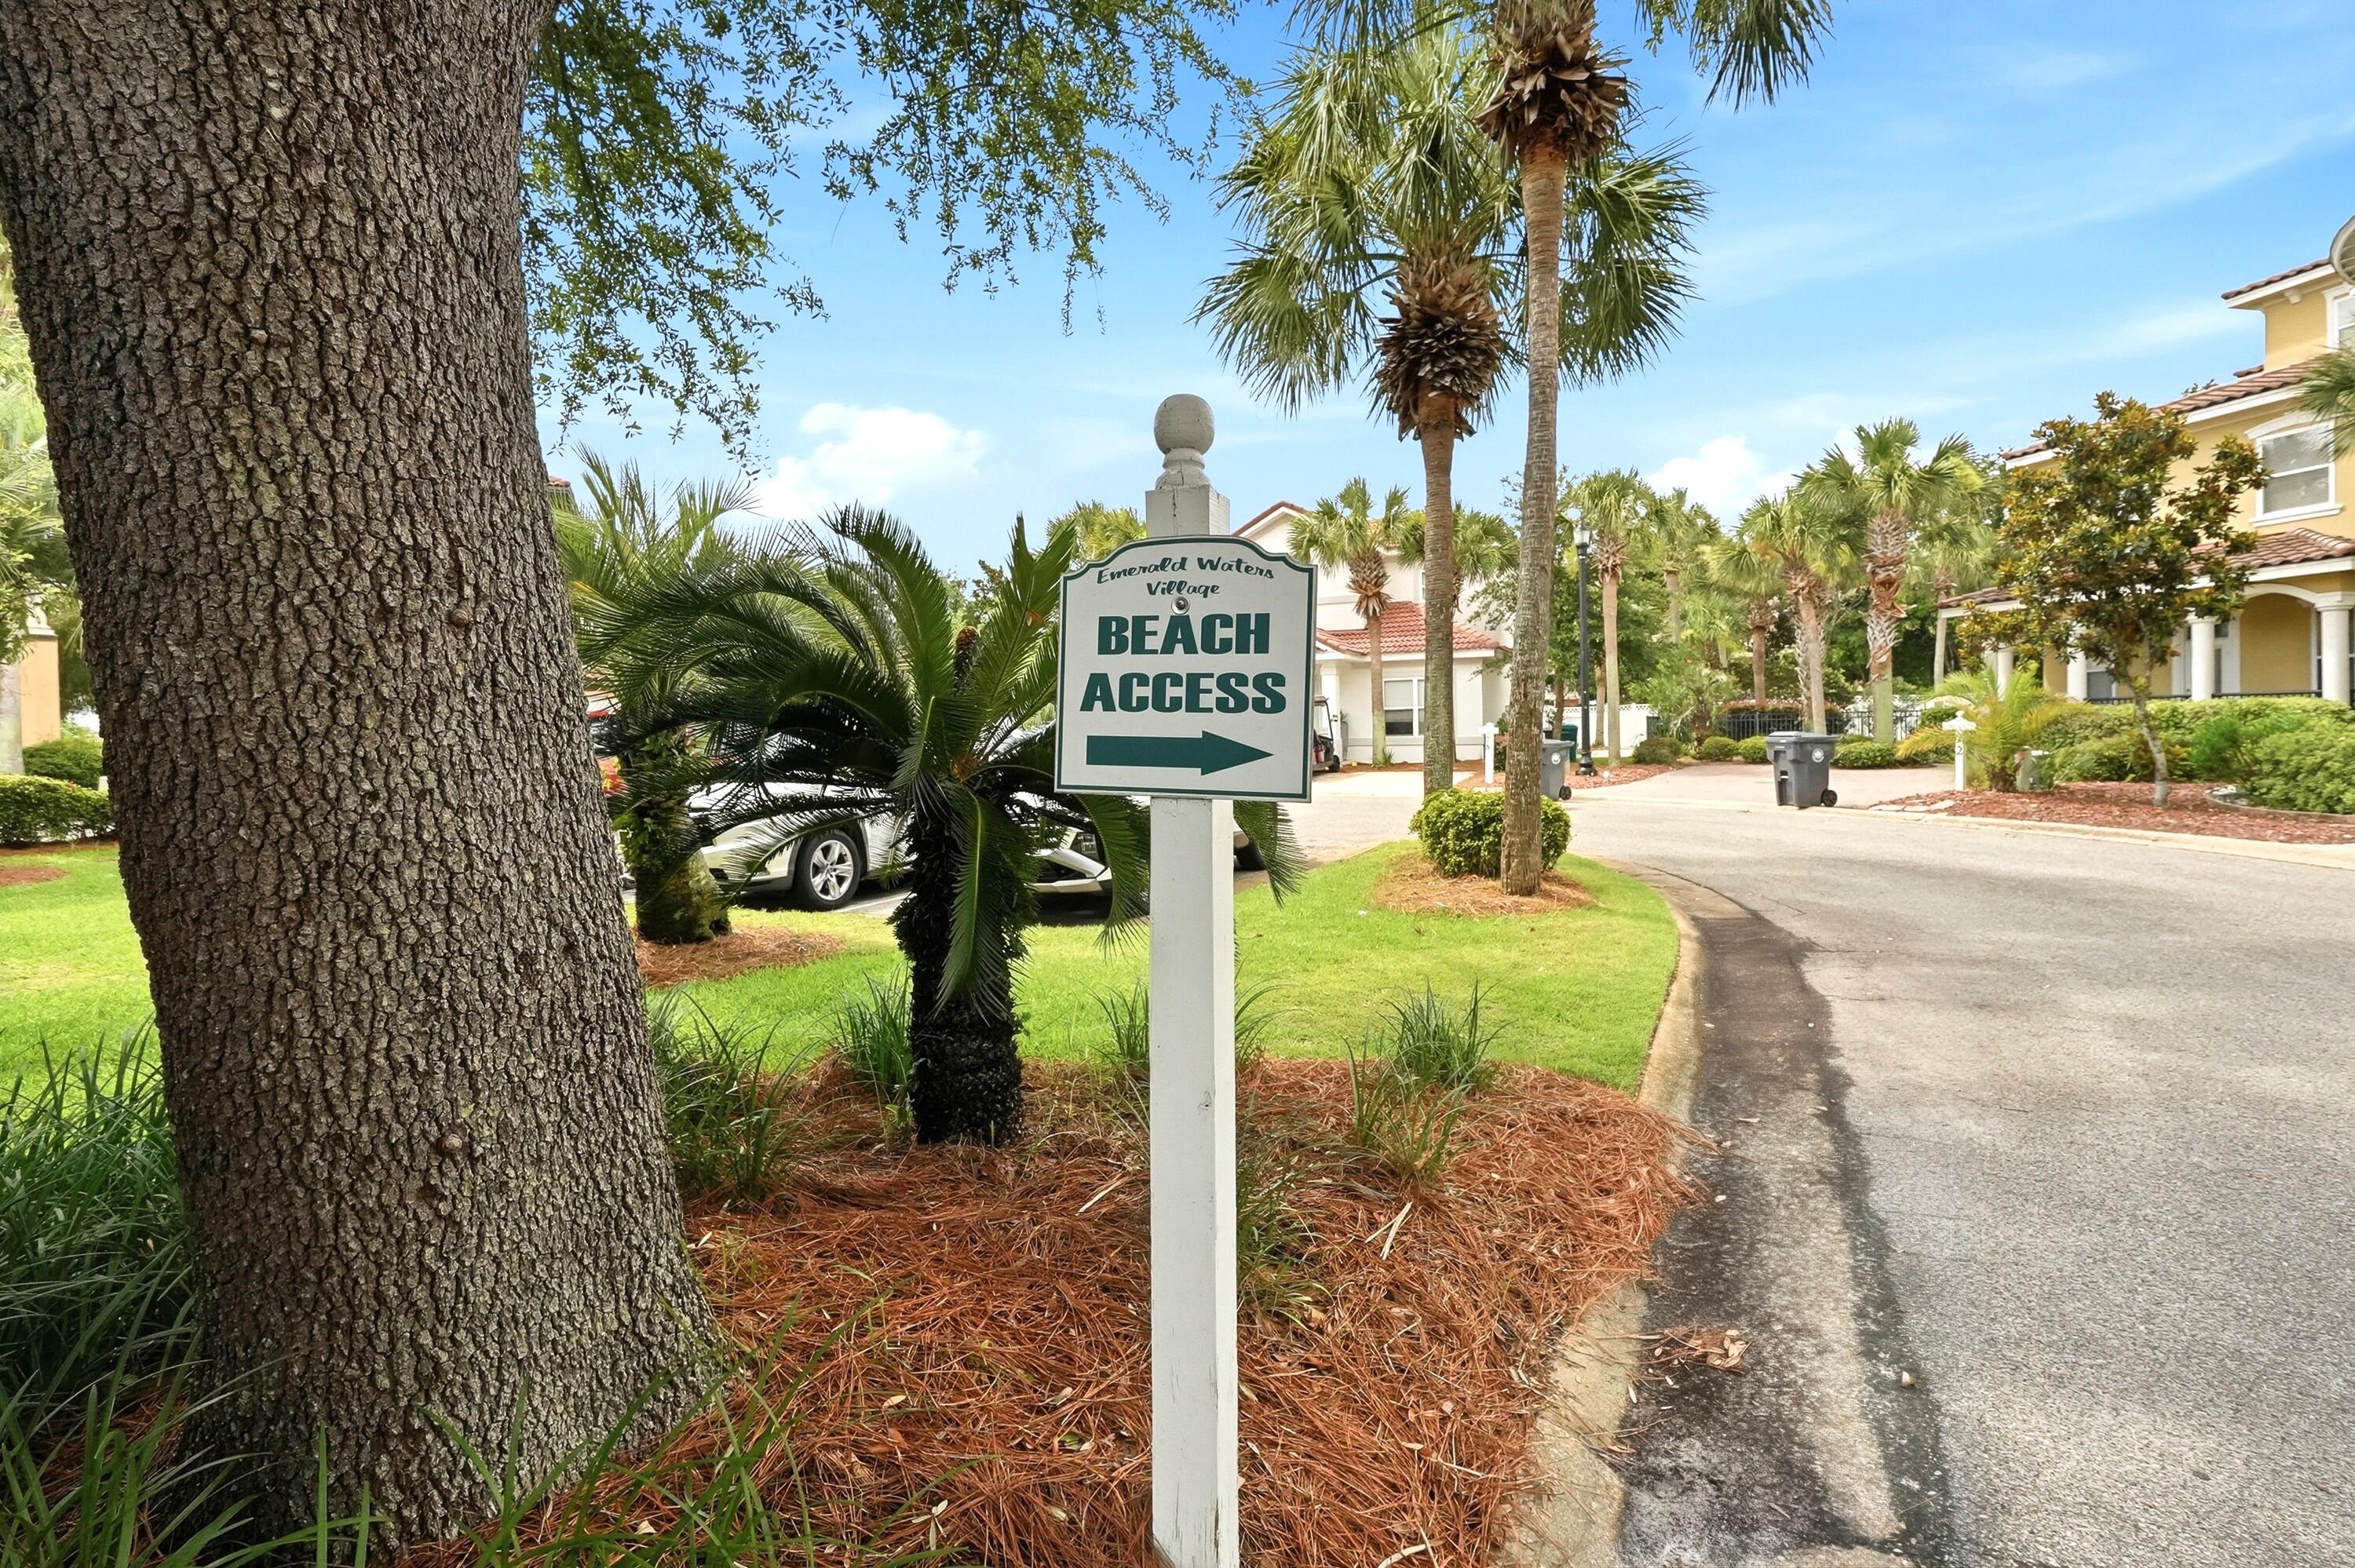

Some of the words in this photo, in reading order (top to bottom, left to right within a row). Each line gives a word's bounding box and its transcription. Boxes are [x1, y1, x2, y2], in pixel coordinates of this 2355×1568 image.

[1097, 556, 1188, 585] Emerald
[1196, 556, 1275, 579] Waters
[1146, 580, 1221, 599] Village
[1097, 612, 1270, 655] BEACH
[1079, 672, 1287, 714] ACCESS
